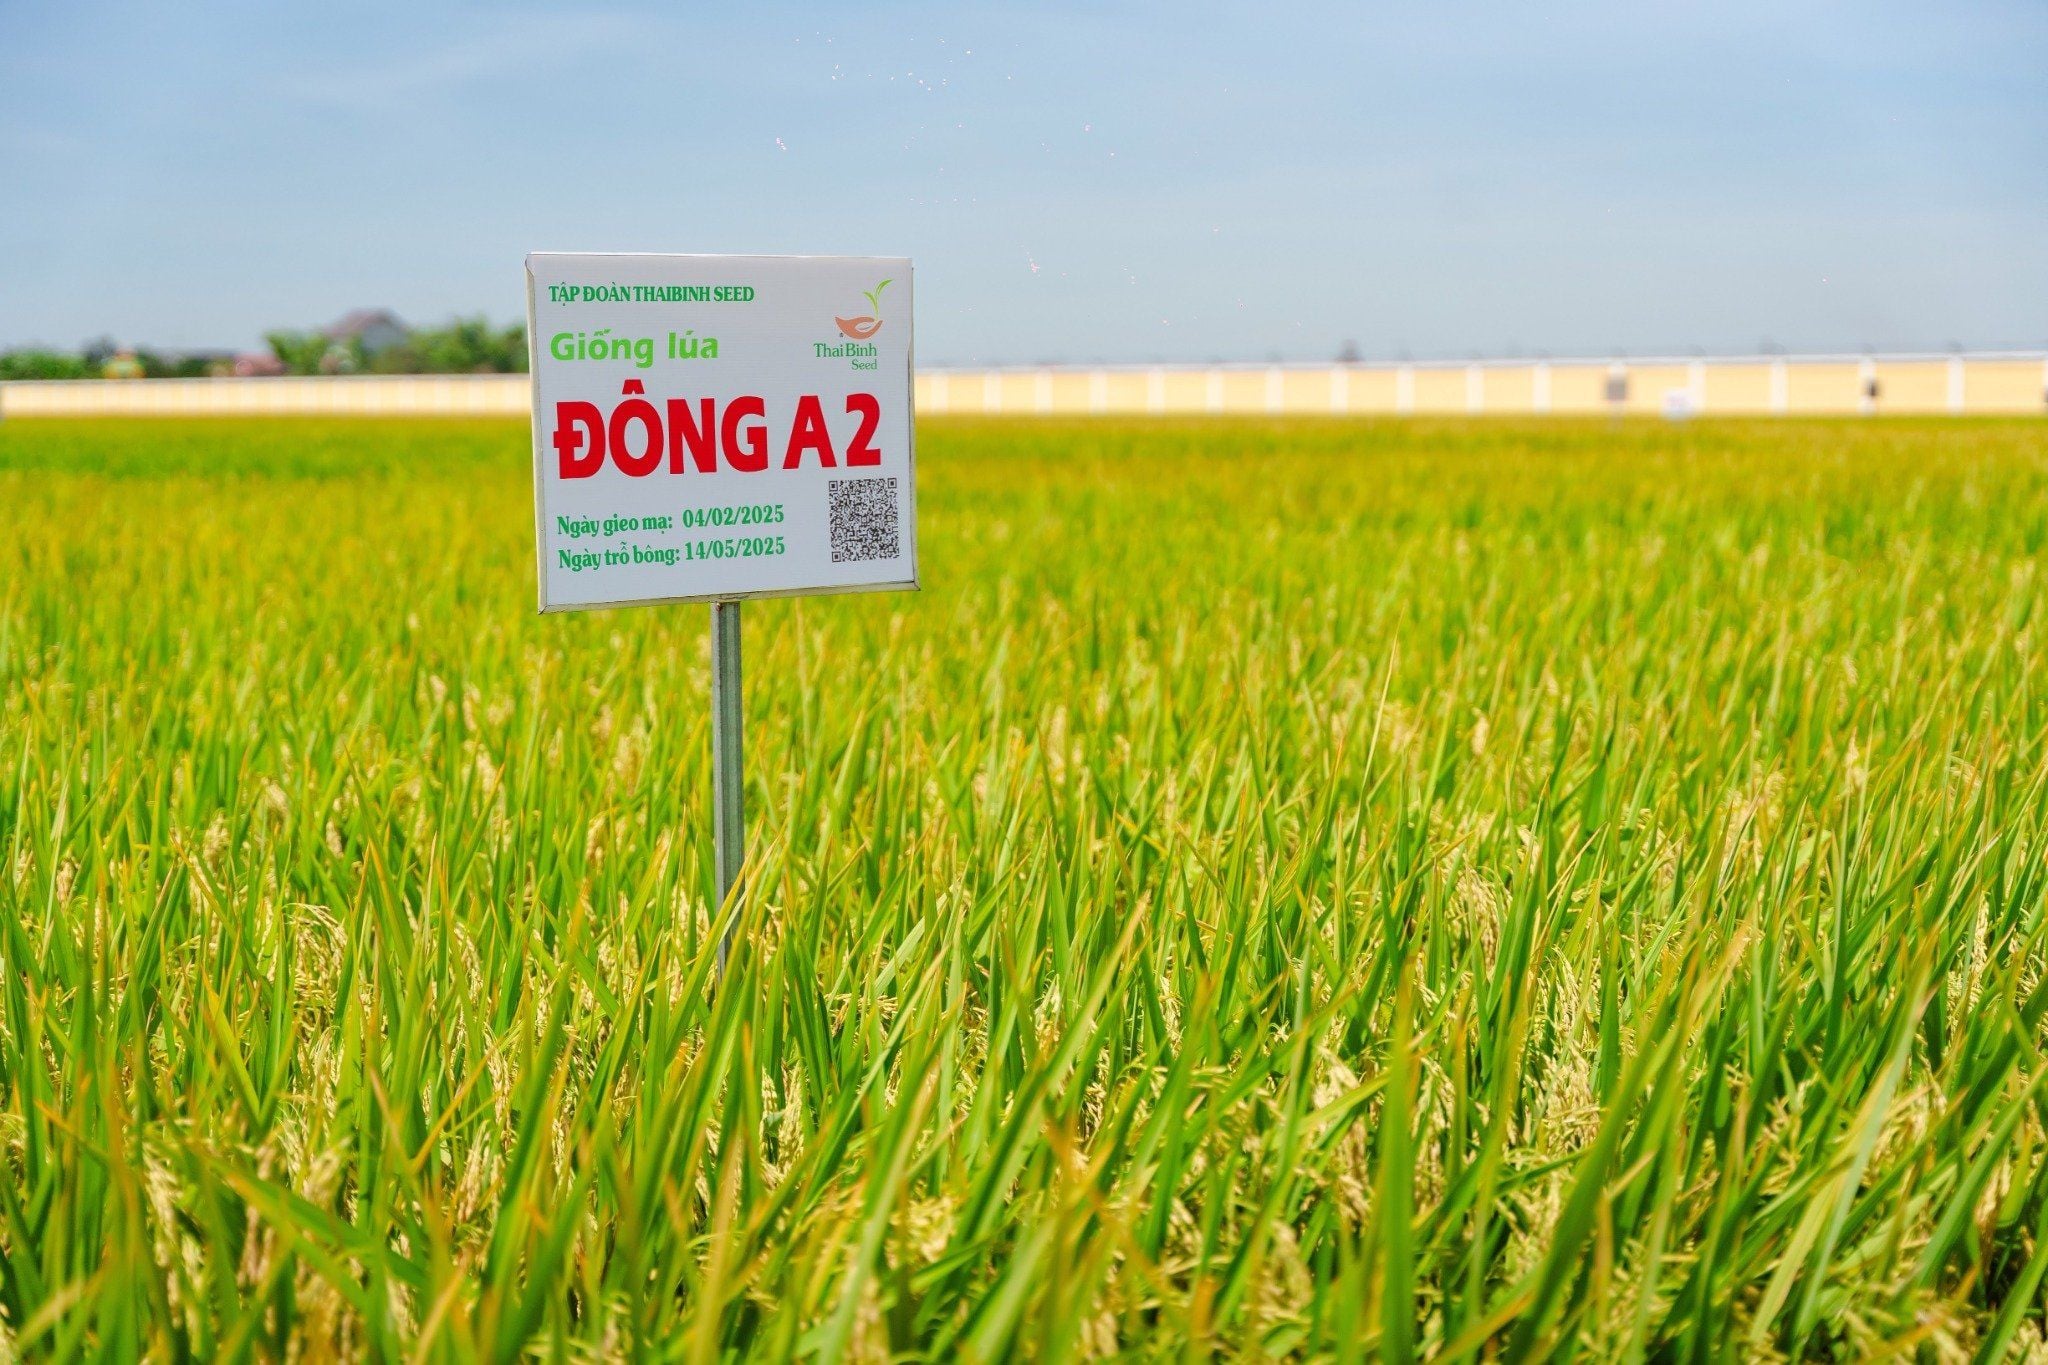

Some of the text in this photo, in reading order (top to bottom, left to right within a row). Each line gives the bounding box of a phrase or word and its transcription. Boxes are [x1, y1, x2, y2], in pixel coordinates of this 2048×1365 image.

[549, 281, 755, 306] TẬP ĐOÀN THAIBINH SEED
[550, 328, 719, 369] Giống lúa
[851, 359, 878, 370] Seed
[553, 379, 882, 479] ĐÔNG A 2
[557, 504, 784, 538] Ngày gieo mạ: 04/02/2025
[558, 548, 601, 572] Ngày
[633, 544, 680, 567] bông:
[685, 536, 786, 560] 14/05/2025
